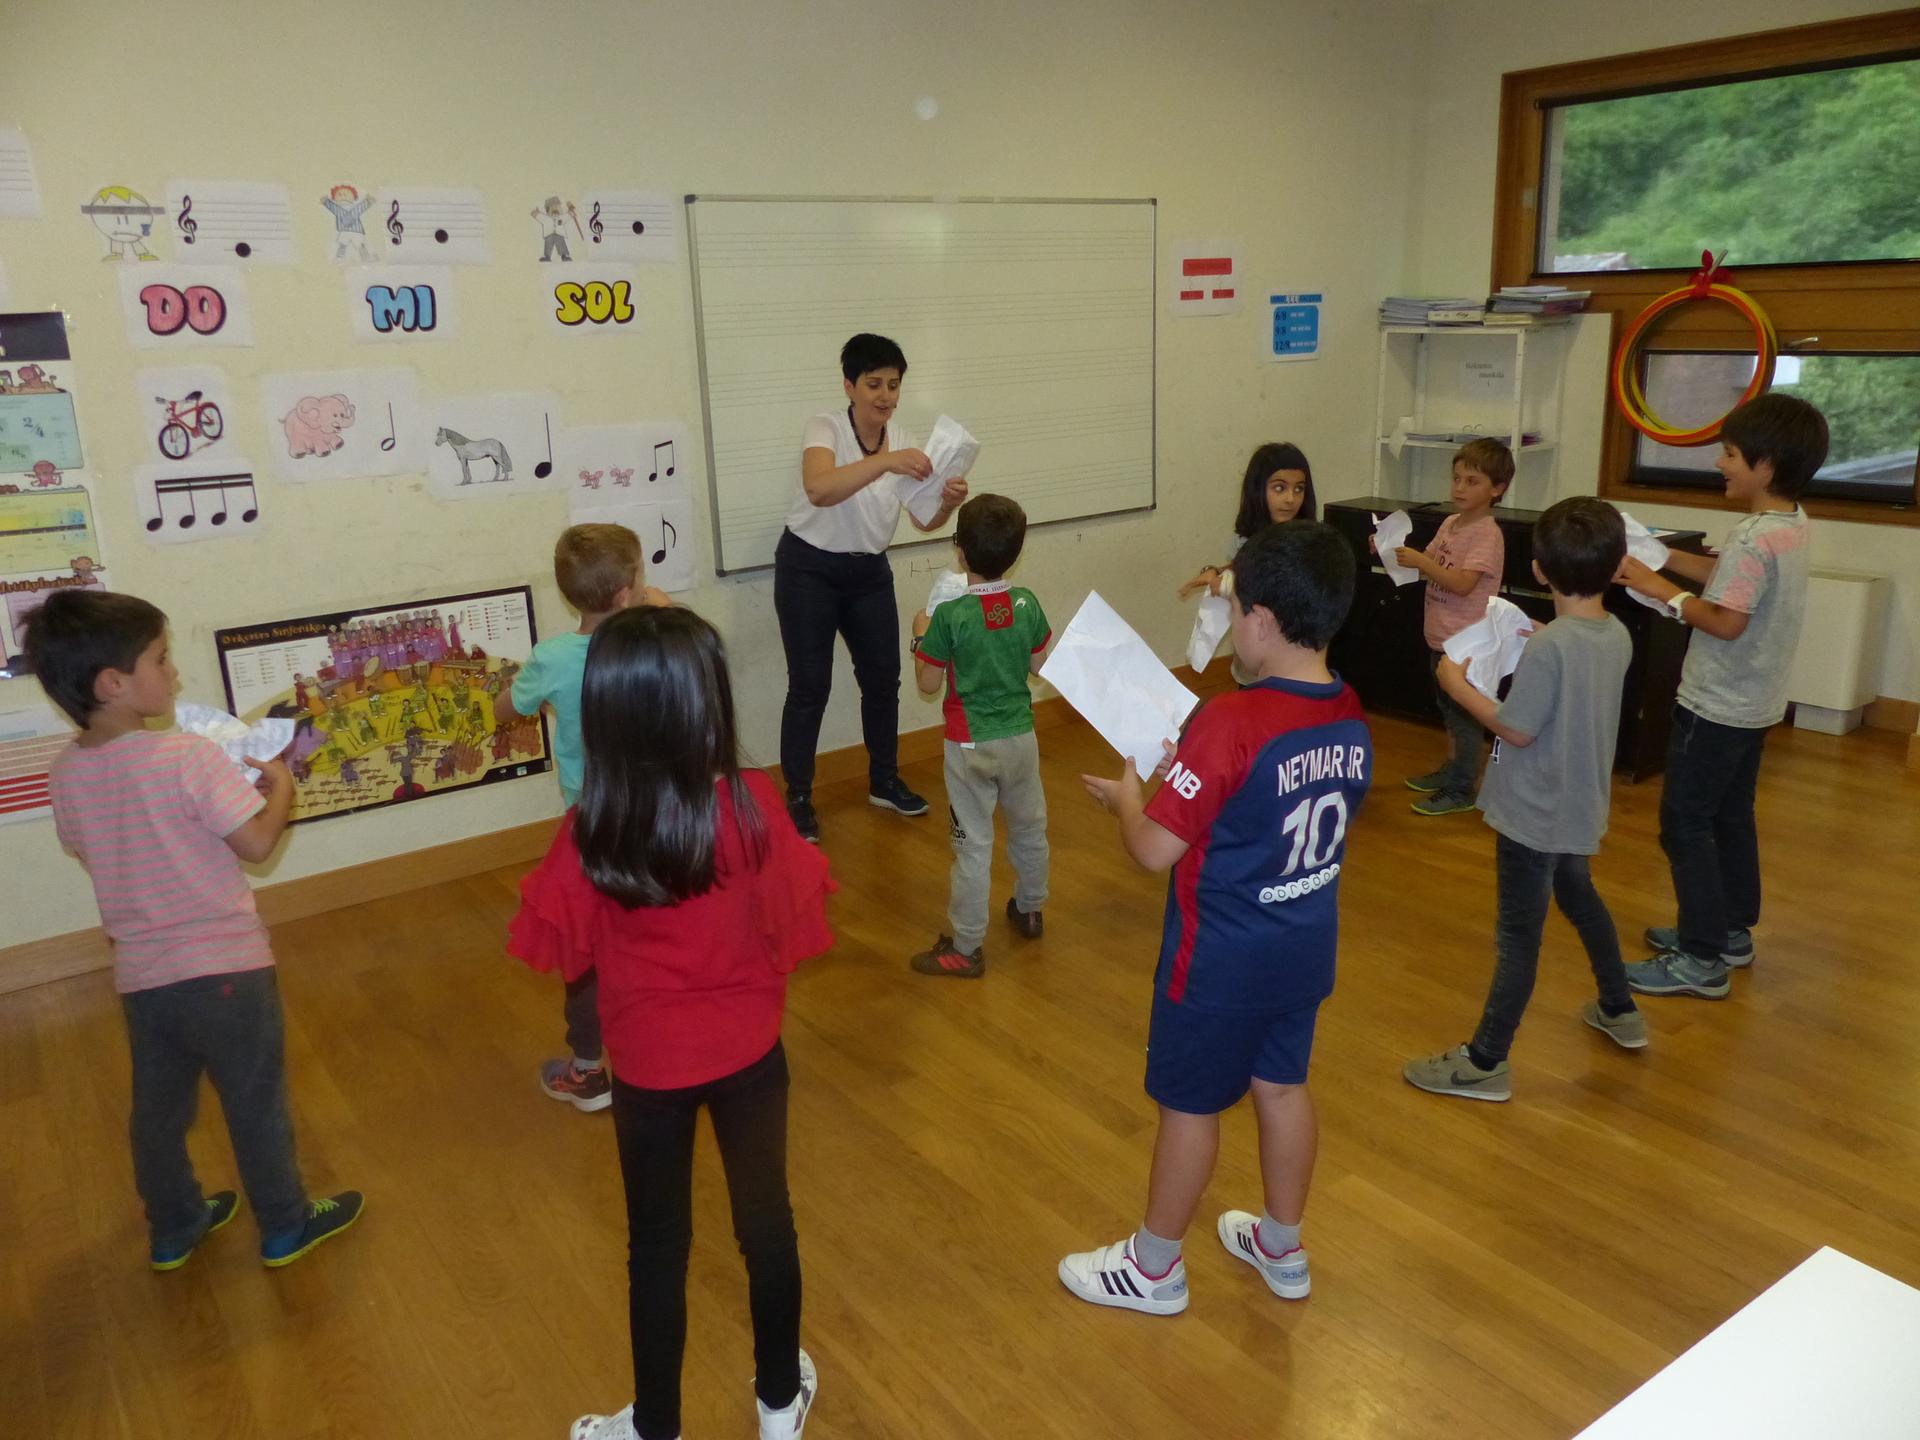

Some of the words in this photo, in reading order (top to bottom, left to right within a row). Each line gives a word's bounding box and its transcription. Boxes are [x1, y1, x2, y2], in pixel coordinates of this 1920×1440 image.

[139, 284, 227, 337] DO
[366, 284, 437, 333] MI
[554, 280, 635, 326] SOL
[1278, 745, 1343, 796] NEYMAR
[1347, 745, 1364, 780] JR
[1278, 792, 1347, 876] 10
[1281, 1267, 1308, 1281] adid
